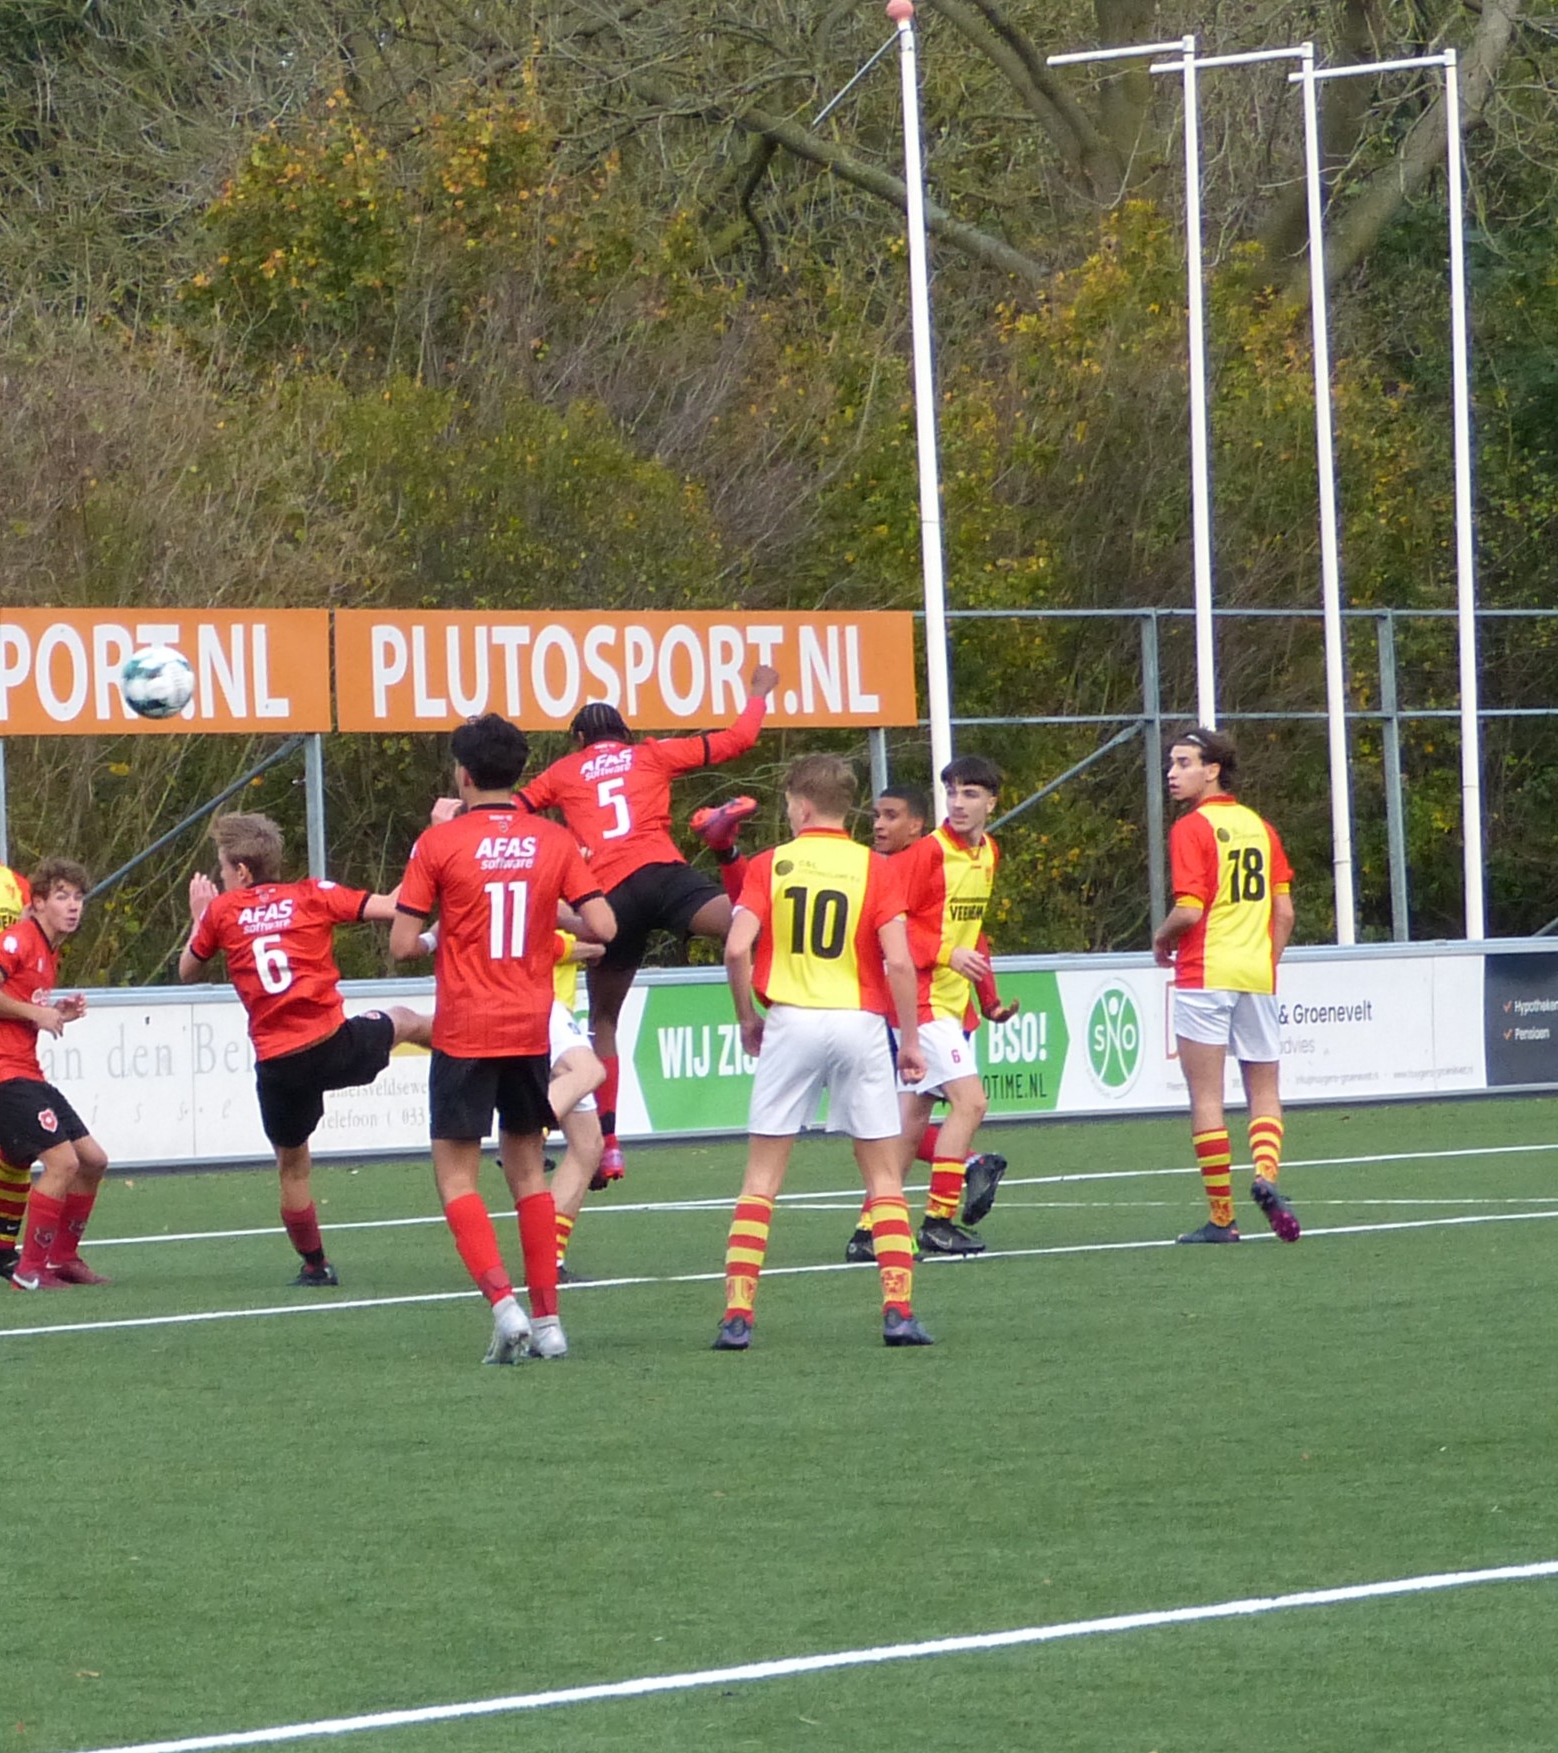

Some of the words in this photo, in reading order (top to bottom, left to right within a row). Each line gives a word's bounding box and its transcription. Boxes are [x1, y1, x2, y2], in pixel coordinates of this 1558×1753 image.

[371, 624, 880, 718] PLUTOSPORT.NL
[580, 748, 633, 775] AFAS
[597, 777, 632, 839] 5
[474, 837, 537, 859] AFAS
[480, 857, 534, 870] software
[1228, 847, 1265, 903] 18
[238, 899, 293, 925] AFAS
[484, 881, 528, 959] 11
[784, 886, 849, 959] 10
[252, 933, 293, 995] 6
[989, 1012, 1047, 1064] BSO!
[1278, 1004, 1289, 1025] &
[1293, 1000, 1373, 1025] Groenevelt
[107, 1021, 175, 1079] den
[658, 1025, 710, 1079] WIJ
[951, 1049, 961, 1064] 6
